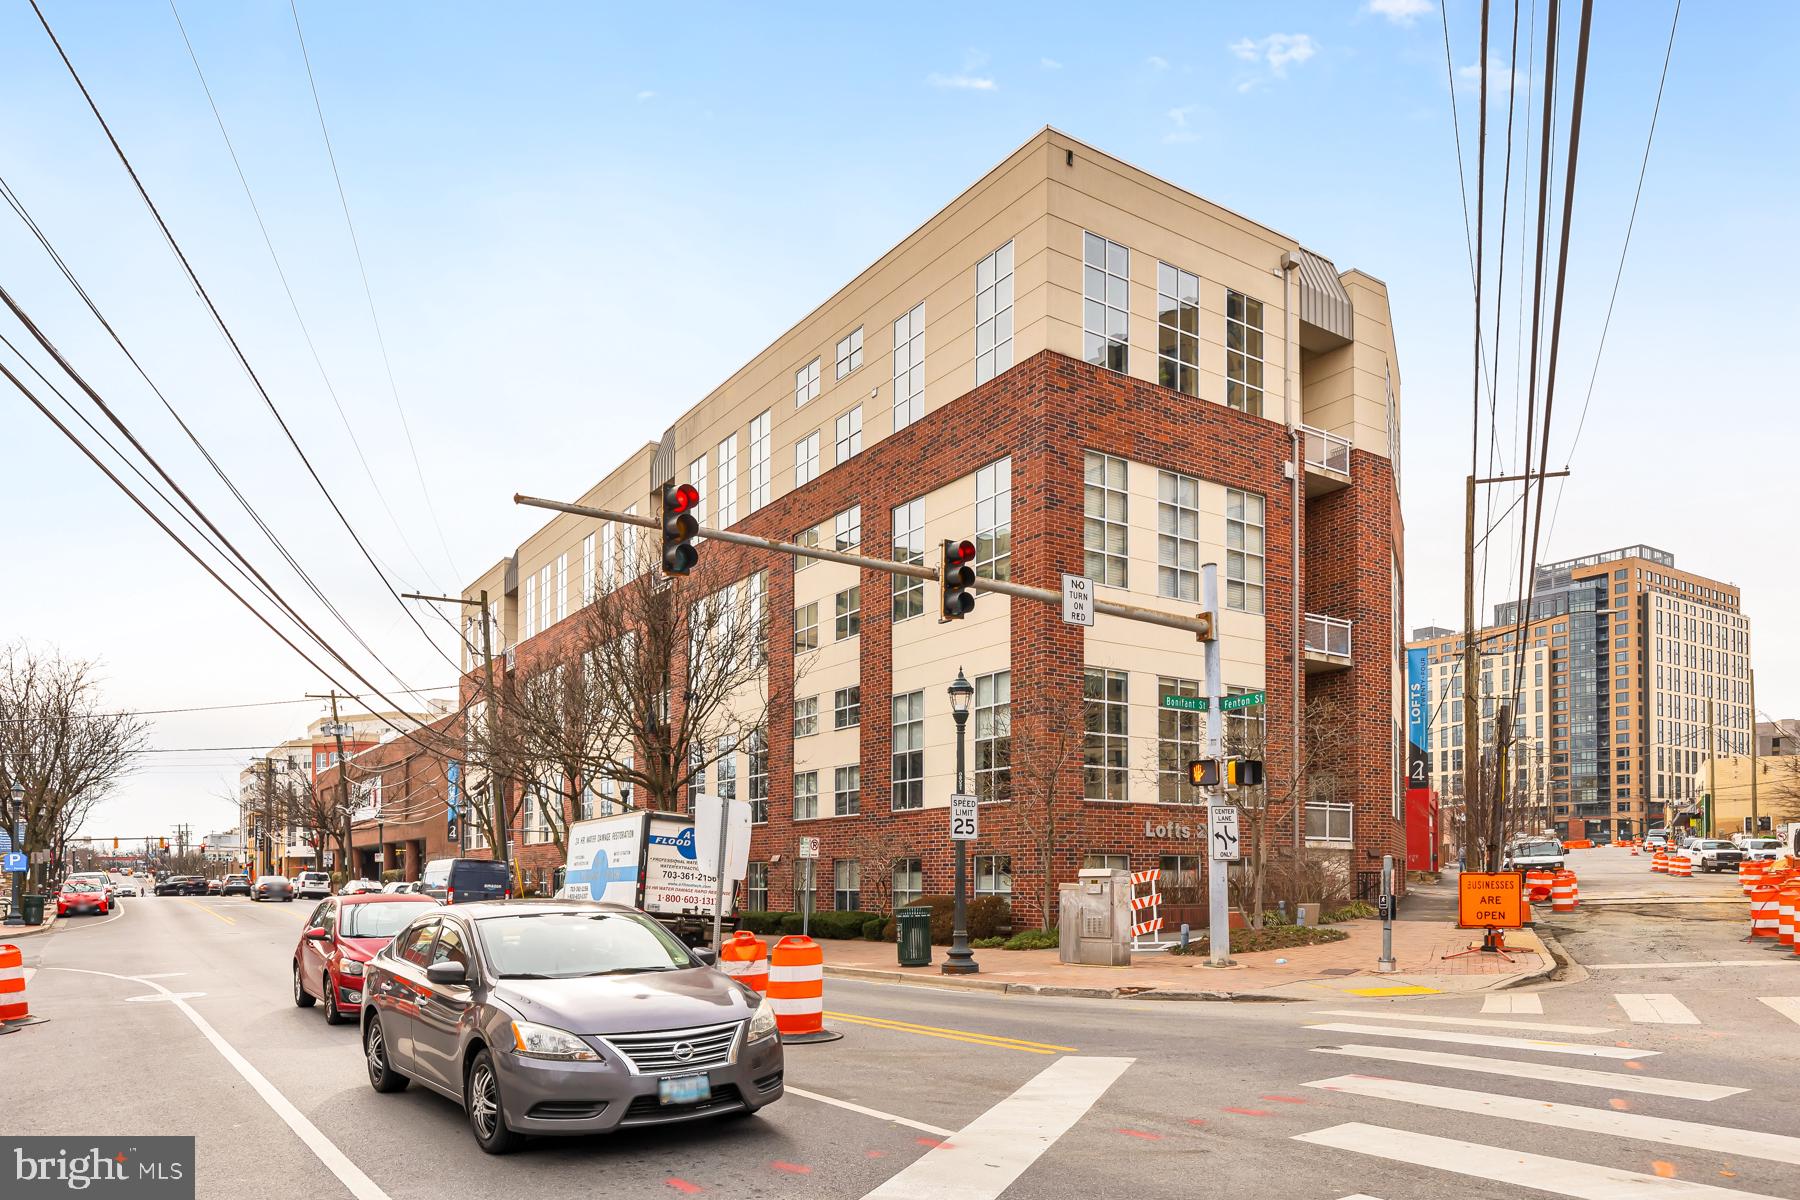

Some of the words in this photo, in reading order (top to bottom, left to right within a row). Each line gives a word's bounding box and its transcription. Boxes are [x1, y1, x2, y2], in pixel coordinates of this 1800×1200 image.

[1071, 579, 1085, 590] NO
[1069, 591, 1088, 600] TURN
[1073, 602, 1084, 611] ON
[1071, 612, 1086, 621] RED
[1166, 696, 1196, 709] Bonifant
[1198, 700, 1206, 710] St
[1224, 697, 1251, 709] Fenton
[1254, 694, 1263, 704] St
[1411, 683, 1420, 725] LOFTS
[953, 799, 976, 808] SPEED
[955, 809, 973, 817] LIMIT
[953, 818, 975, 835] 25
[1145, 820, 1191, 839] Lofts
[1196, 823, 1208, 839] 2
[655, 837, 692, 847] FLOOD
[10, 854, 20, 866] P
[1467, 880, 1514, 890] BUSINESSES
[1479, 895, 1502, 905] ARE
[1476, 911, 1506, 920] OPEN
